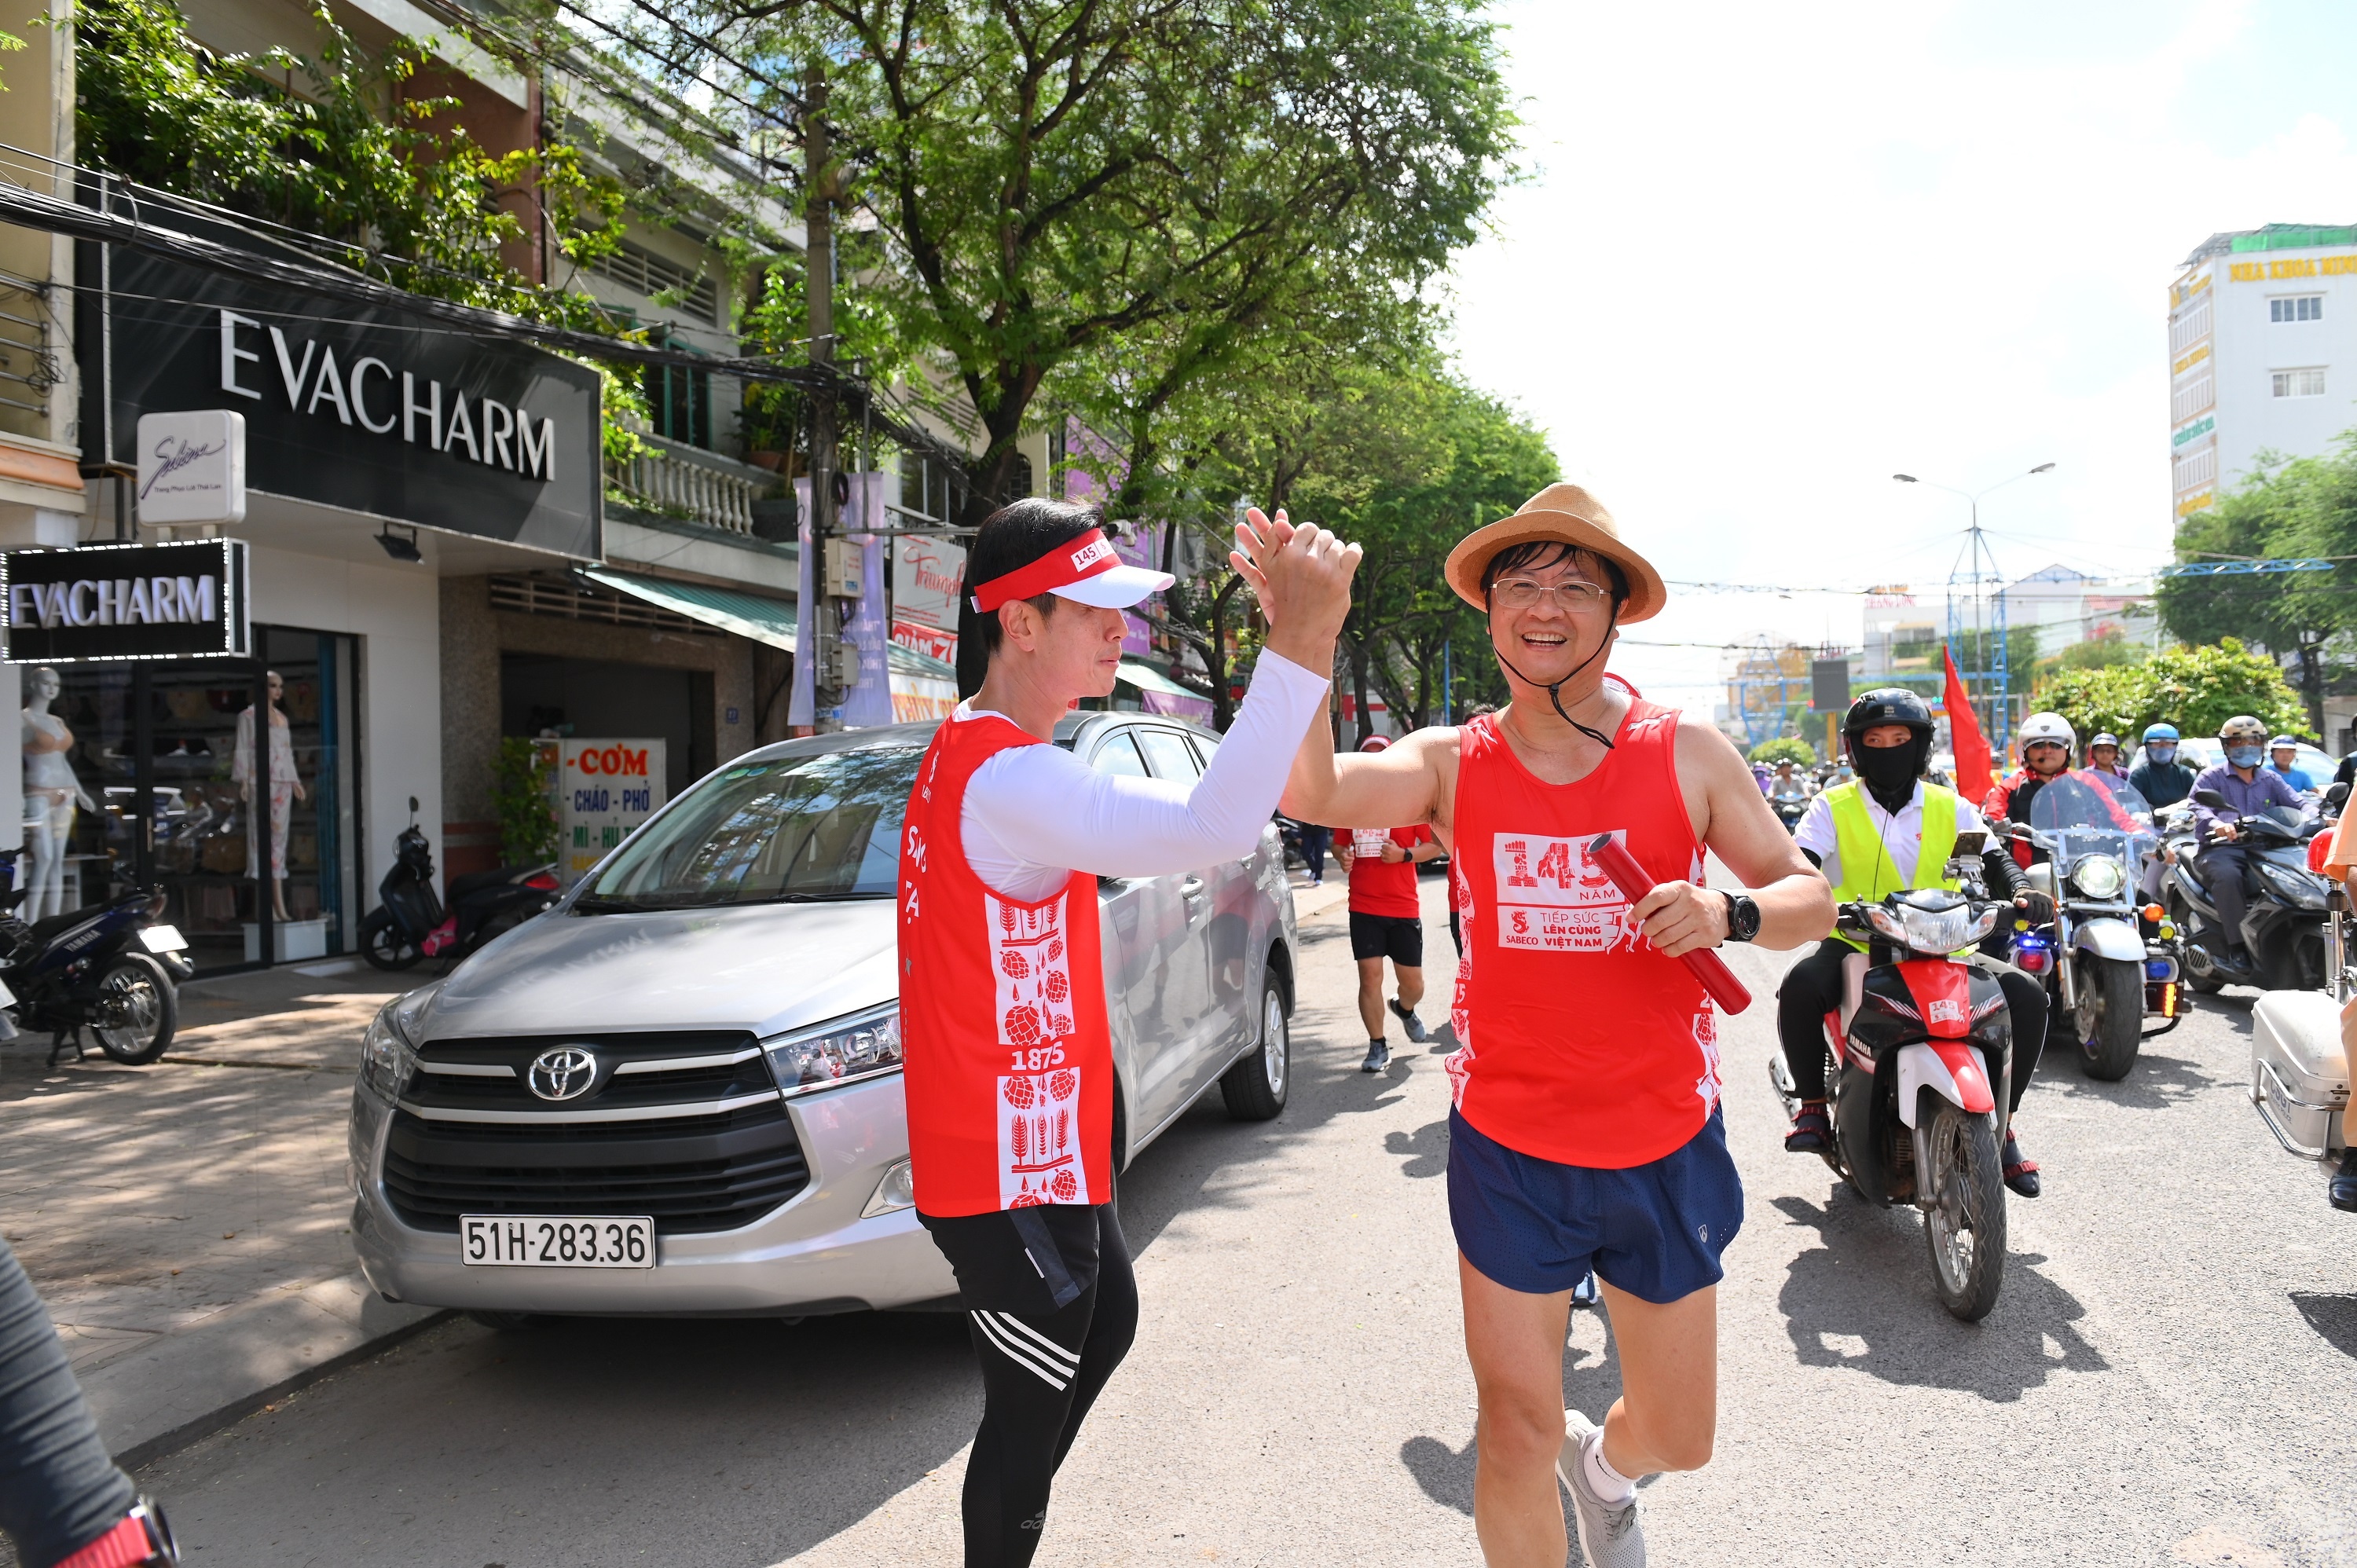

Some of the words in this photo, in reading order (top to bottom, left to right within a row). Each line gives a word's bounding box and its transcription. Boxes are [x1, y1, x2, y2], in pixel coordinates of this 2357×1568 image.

[2230, 262, 2265, 283] NHA
[2270, 259, 2317, 279] KHOA
[220, 310, 555, 482] EVACHARM
[1075, 547, 1096, 565] 145
[9, 574, 216, 628] EVACHARM
[574, 784, 609, 812] CHÁO
[1579, 888, 1615, 900] NĂM
[1540, 910, 1569, 923] TIẾP
[1574, 911, 1600, 923] SỨC
[63, 929, 102, 952] YAMAHA
[1506, 935, 1538, 945] SABECO
[1543, 924, 1567, 935] LÊN
[1568, 925, 1601, 935] CÙNG
[1545, 936, 1571, 949] VIỆT
[1574, 938, 1602, 947] NAM
[1011, 1041, 1065, 1071] 1875
[1849, 1032, 1871, 1057] YAMAHA
[468, 1222, 645, 1262] 51H-283.36
